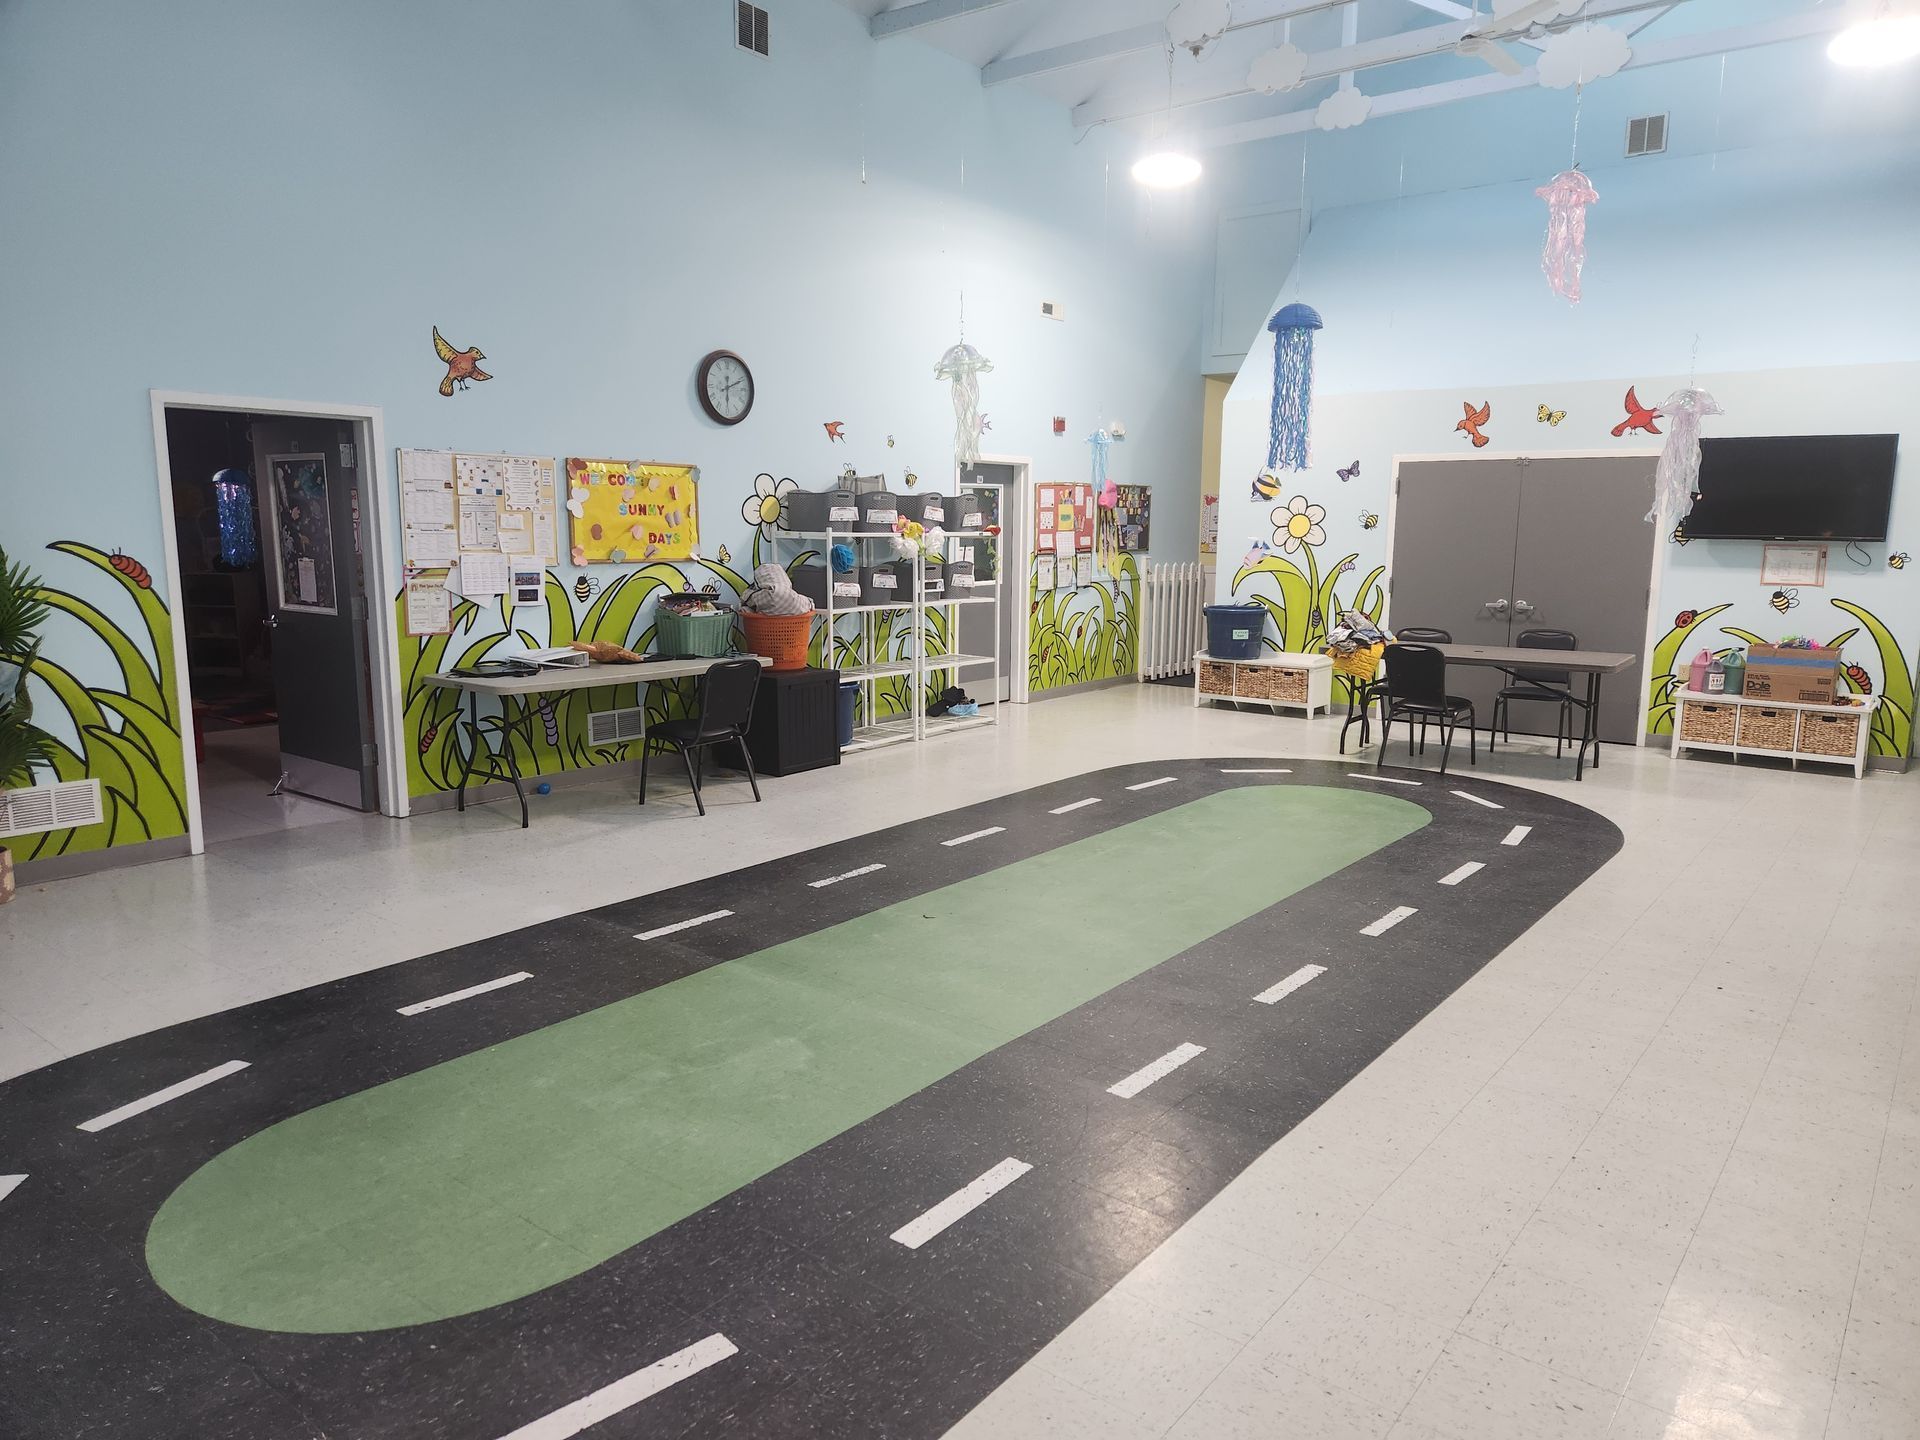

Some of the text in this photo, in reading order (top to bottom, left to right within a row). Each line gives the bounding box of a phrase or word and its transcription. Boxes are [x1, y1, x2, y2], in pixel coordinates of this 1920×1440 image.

[618, 503, 665, 516] SUNNY
[648, 532, 680, 544] DAYS
[1746, 680, 1771, 690] Dole
